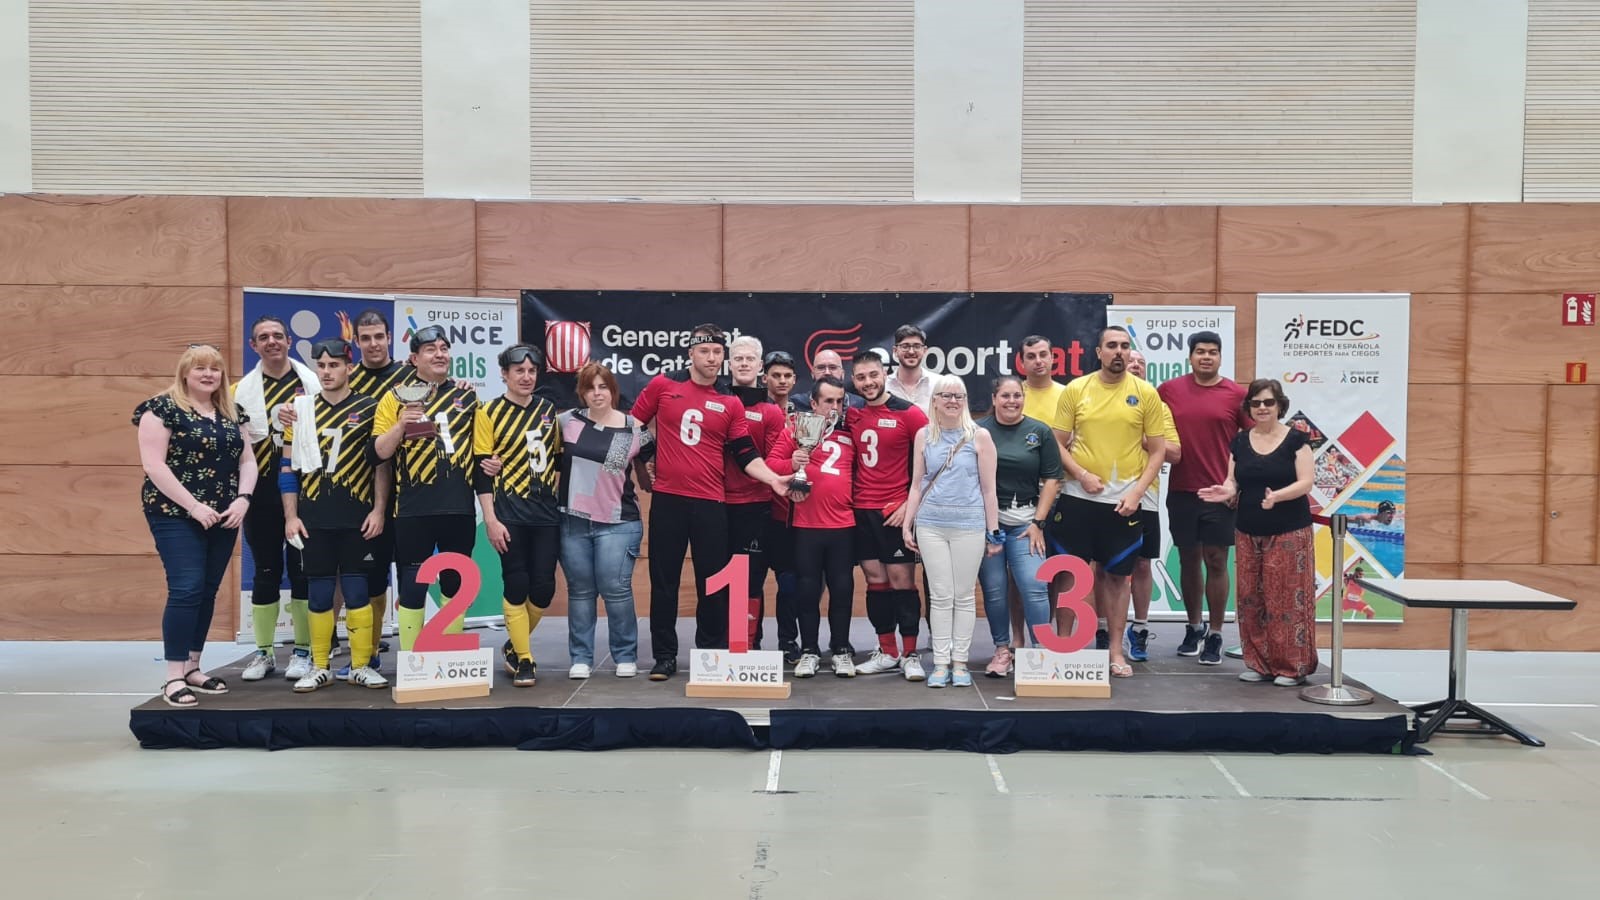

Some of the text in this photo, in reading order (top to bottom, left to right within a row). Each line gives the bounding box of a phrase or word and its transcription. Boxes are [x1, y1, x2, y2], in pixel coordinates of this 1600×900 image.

[428, 310, 503, 321] grup social
[1146, 317, 1220, 330] grup social
[438, 325, 503, 345] NCE
[602, 324, 741, 348] Generaat
[1306, 319, 1364, 336] FEDC
[1146, 332, 1190, 351] ON
[1283, 342, 1380, 350] FEDERACIÓN ESPAÑOLA
[448, 352, 486, 378] als
[601, 353, 633, 375] de
[1350, 376, 1379, 384] ONCE
[435, 411, 455, 454] 1
[680, 409, 704, 446] 6
[322, 428, 343, 473] 7
[525, 429, 548, 473] 5
[820, 440, 842, 476] 2
[860, 429, 879, 468] 3
[412, 551, 481, 652] 2
[705, 554, 750, 654] 1
[1032, 554, 1098, 654] 3
[448, 667, 488, 679] ONCE
[739, 672, 778, 682] ONCE
[1064, 670, 1104, 681] ONCE
